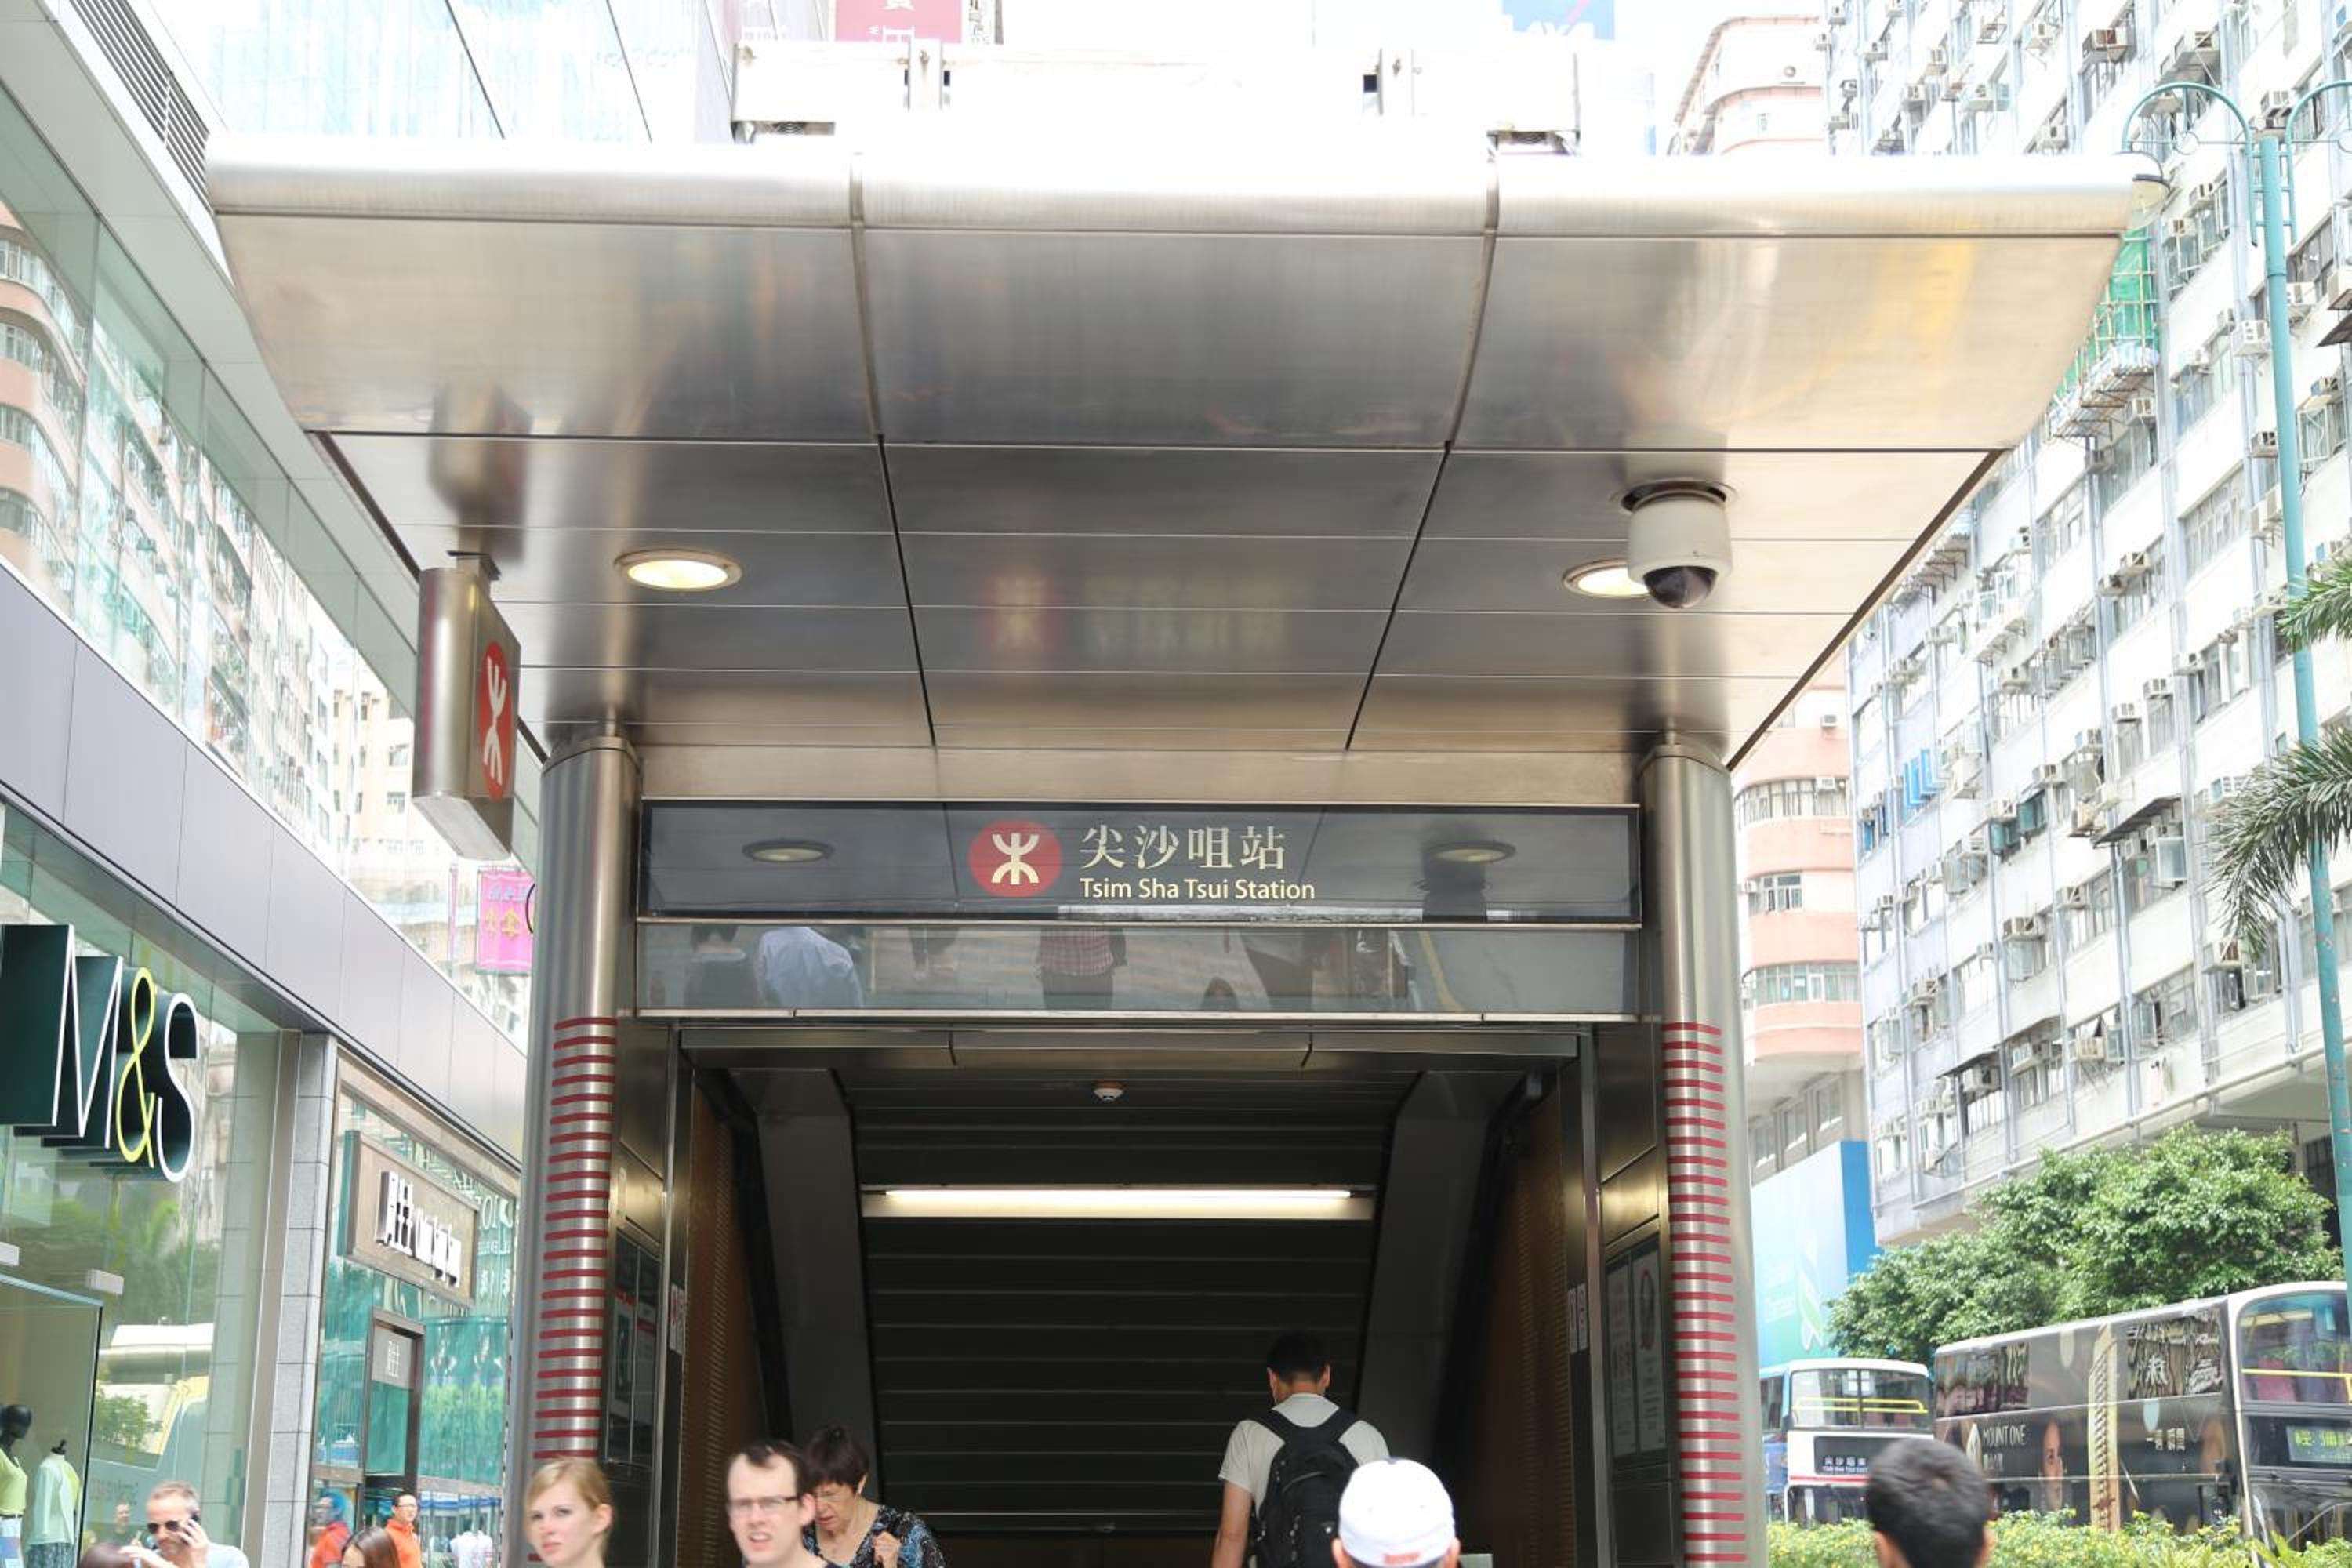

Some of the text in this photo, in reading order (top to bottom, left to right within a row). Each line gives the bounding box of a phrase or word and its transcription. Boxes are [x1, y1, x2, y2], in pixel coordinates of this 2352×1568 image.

[1080, 824, 1285, 870] 尖沙咀站
[1080, 877, 1316, 900] Tsim Sha Tsui Station
[52, 924, 199, 1183] M&S
[2009, 1424, 2027, 1446] ONE
